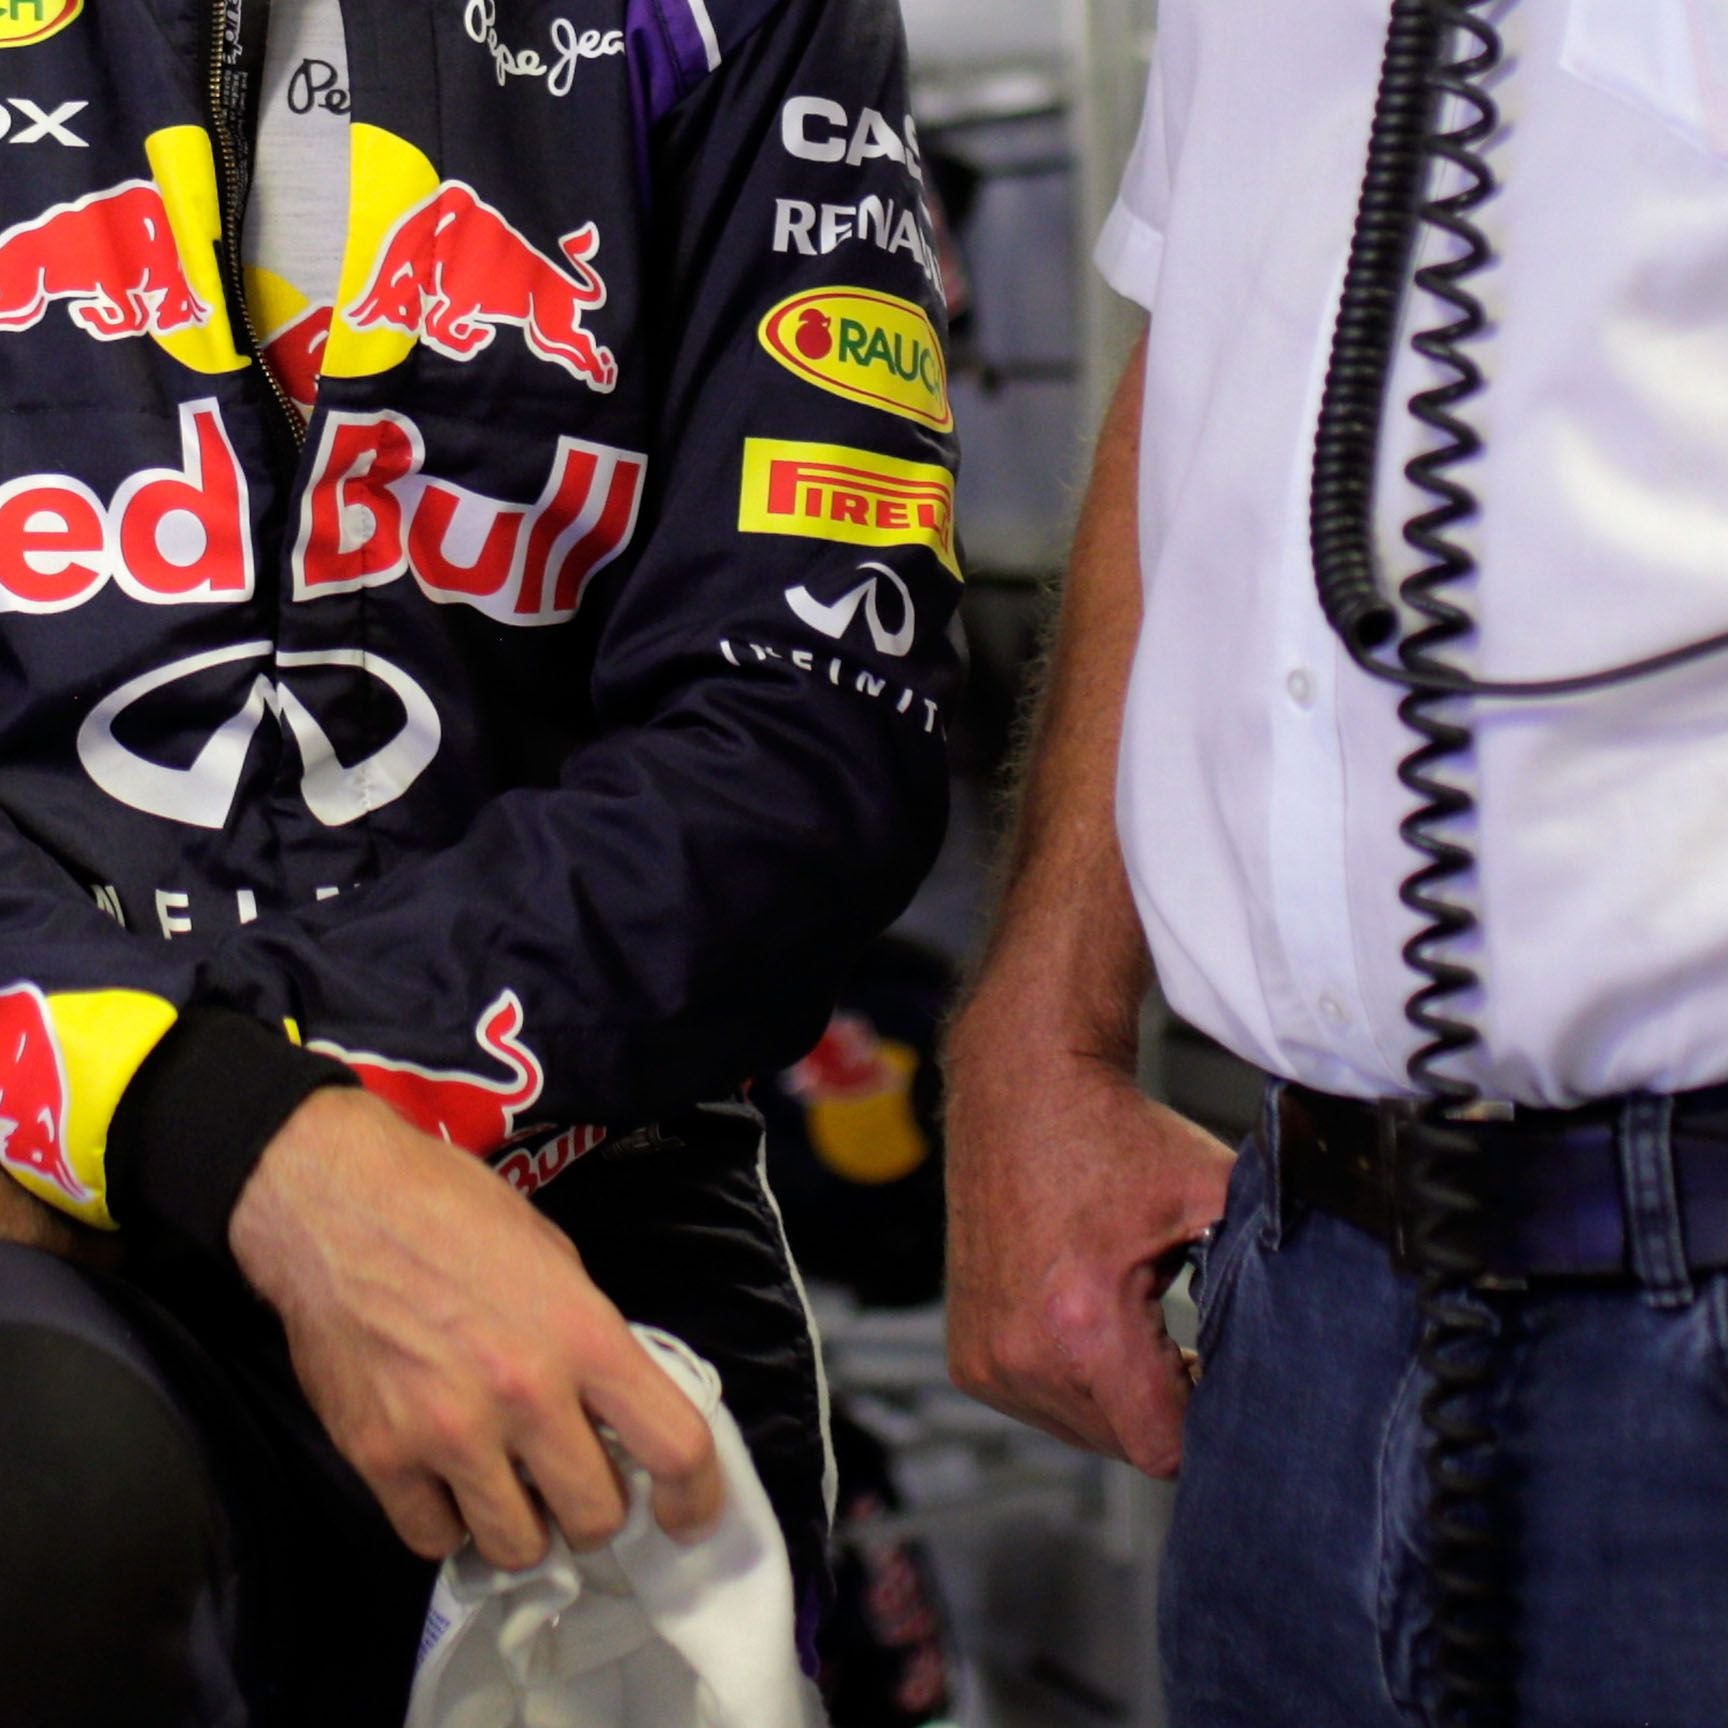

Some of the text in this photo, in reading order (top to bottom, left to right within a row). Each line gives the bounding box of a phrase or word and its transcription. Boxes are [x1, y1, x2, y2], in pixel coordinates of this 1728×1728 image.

[287, 57, 352, 116] Pe
[547, 17, 626, 97] Jea
[838, 317, 940, 402] RAUC
[291, 408, 649, 627] Bull
[492, 1123, 608, 1200] Bull
